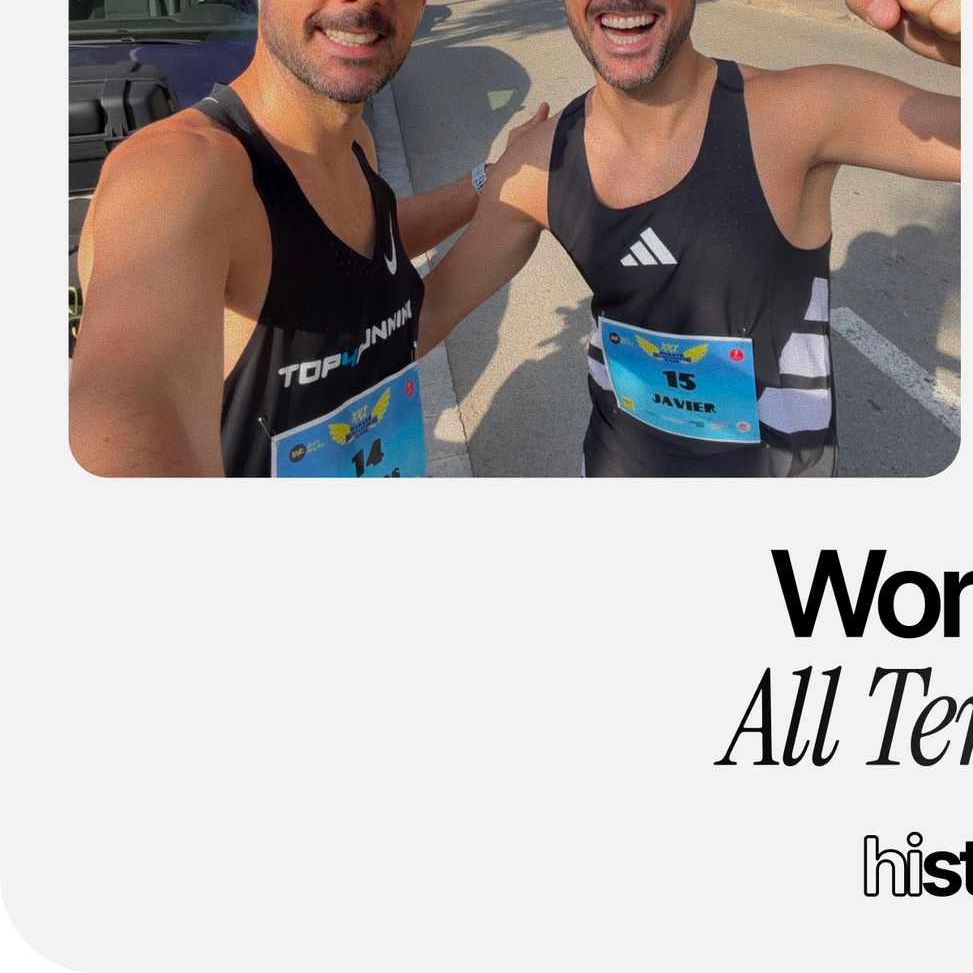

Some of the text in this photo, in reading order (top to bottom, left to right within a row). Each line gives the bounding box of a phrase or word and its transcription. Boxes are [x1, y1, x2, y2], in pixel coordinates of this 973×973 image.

[661, 370, 697, 391] 15
[652, 393, 717, 413] JAVIER
[351, 437, 385, 477] 14
